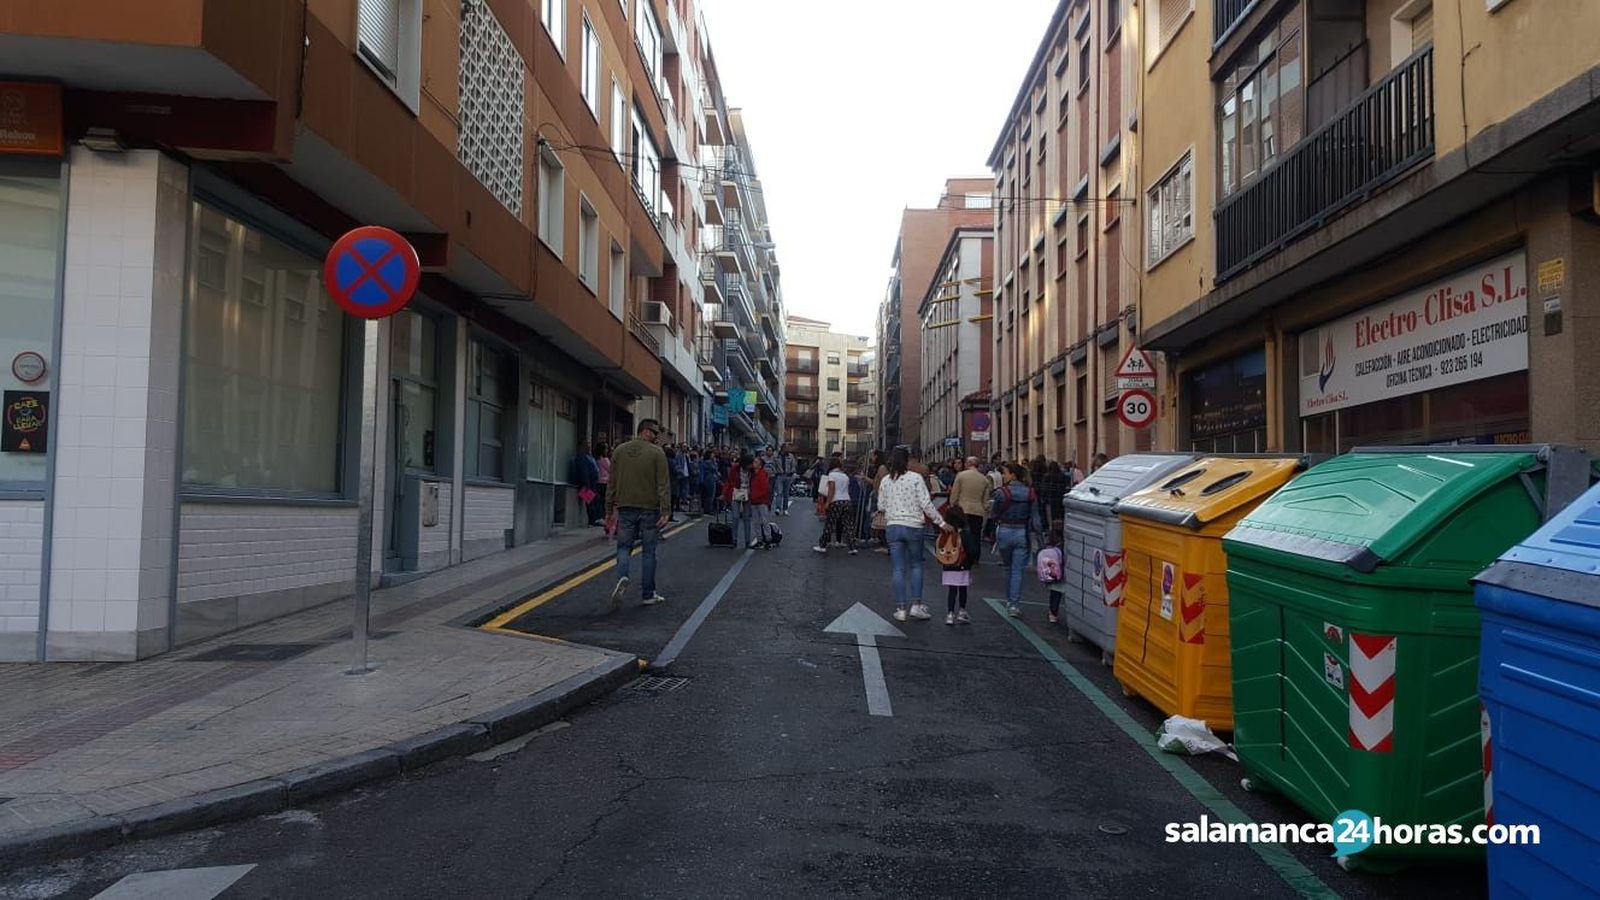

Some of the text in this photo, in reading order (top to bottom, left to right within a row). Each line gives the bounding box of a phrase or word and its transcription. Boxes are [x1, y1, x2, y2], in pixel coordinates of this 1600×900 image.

[1355, 286, 1476, 349] Electro-Clisa
[1481, 265, 1529, 308] S.L.
[1397, 348, 1411, 366] AIRE
[1412, 333, 1466, 361] ACONDICIONADO
[1472, 315, 1528, 346] ELECTRICIDAD
[1440, 358, 1454, 376] 923
[1454, 354, 1468, 373] 265
[1470, 351, 1483, 369] 194
[1126, 402, 1147, 415] 30
